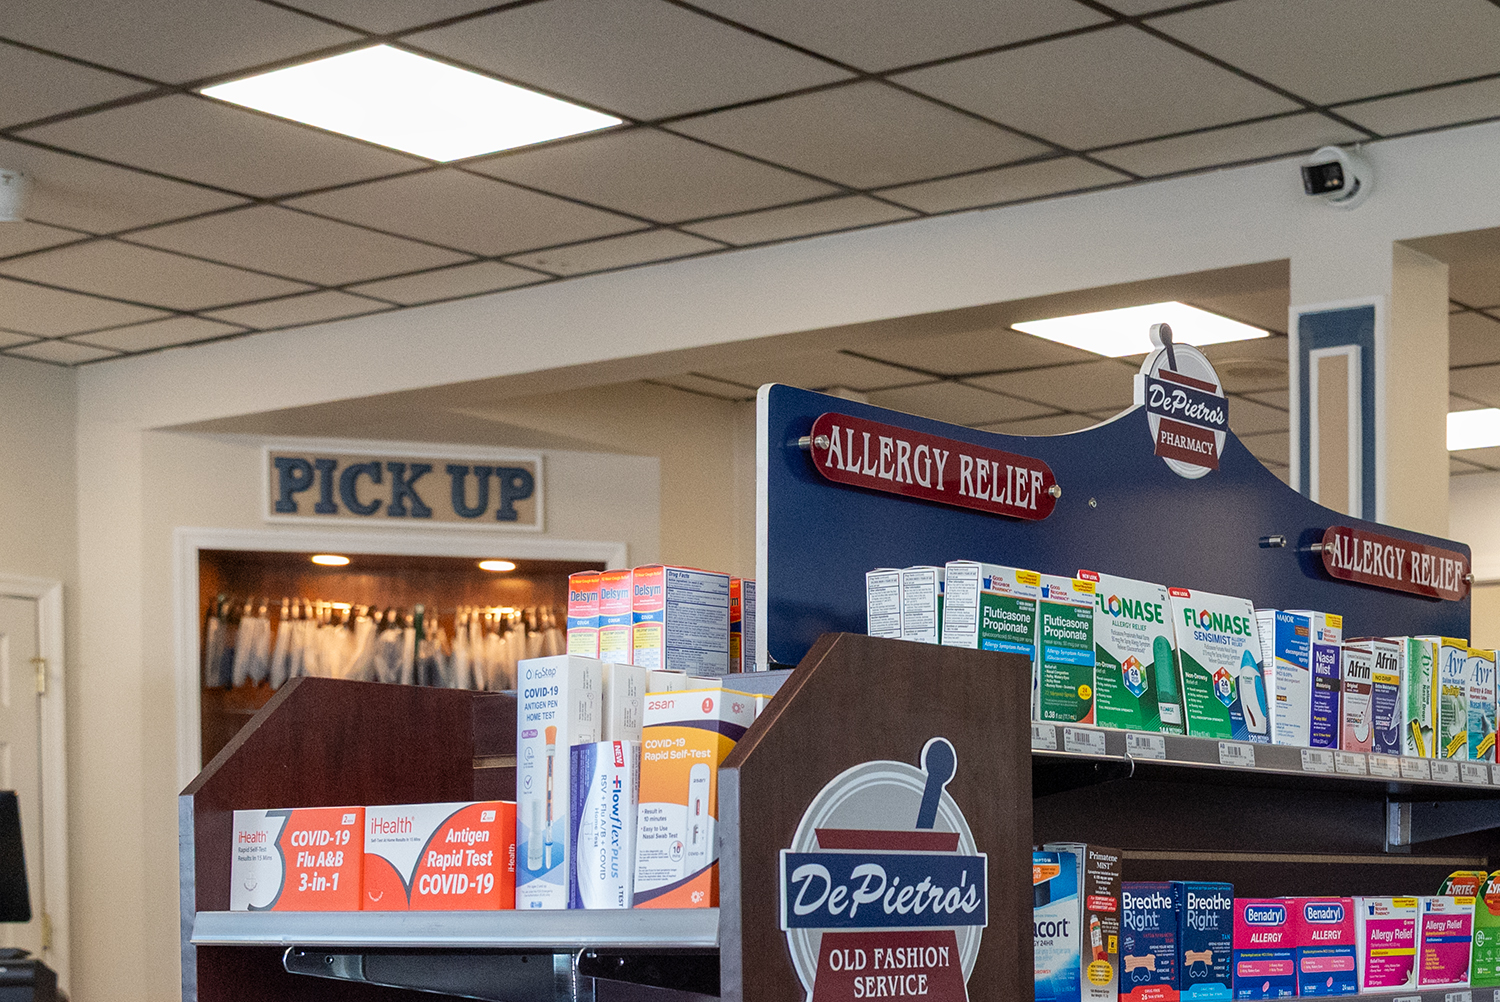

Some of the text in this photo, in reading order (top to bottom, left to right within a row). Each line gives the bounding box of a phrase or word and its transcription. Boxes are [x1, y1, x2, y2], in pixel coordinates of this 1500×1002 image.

[1147, 383, 1225, 425] DePietro's
[1160, 431, 1214, 455] PHARMACY
[825, 425, 1044, 510] ALLERGY RELIEF
[275, 457, 534, 521] PICK UP
[1331, 534, 1463, 592] ALLERGY RELIEF
[570, 590, 598, 602] Delsym
[601, 589, 628, 600] Delsym
[635, 585, 661, 596] Delsym
[984, 606, 1031, 623] Fluticasone
[1044, 615, 1089, 630] Fluticasone
[1184, 608, 1251, 636] FLONASE
[983, 618, 1028, 634] Propionate
[1044, 625, 1087, 641] Propionate
[1194, 631, 1231, 645] SENSIMIST
[1316, 651, 1335, 665] Nasal
[1375, 652, 1397, 670] Afrin
[1316, 663, 1331, 675] Mist
[1347, 660, 1370, 680] Afrin
[524, 686, 558, 698] COVID-19
[649, 700, 675, 710] 2san
[645, 738, 685, 748] COVID-19
[645, 749, 711, 762] Rapid Self-Test
[611, 775, 622, 846] Flowflex
[371, 817, 411, 834] iHealth
[238, 831, 267, 843] iHealth
[291, 830, 350, 846] COVID-19
[446, 829, 489, 845] Antigen
[297, 851, 344, 868] Flu A&B
[428, 851, 493, 870] Rapid Test
[299, 874, 339, 891] 3-in-1
[420, 874, 494, 894] COVID-19
[791, 863, 980, 918] DePietro's
[1123, 892, 1172, 910] Breathe
[1187, 893, 1231, 910] Breathe
[1123, 910, 1158, 931] Right
[1187, 911, 1218, 931] Right
[1248, 907, 1283, 924] Benadryl
[1307, 905, 1341, 923] Benadryl
[1425, 919, 1462, 931] Allergy Relief
[1250, 932, 1283, 944] ALLERGY
[1312, 930, 1342, 941] ALLERGY
[1370, 928, 1413, 941] Allergy Relief
[829, 947, 949, 970] OLD FASHION
[854, 974, 928, 998] SERVICE
